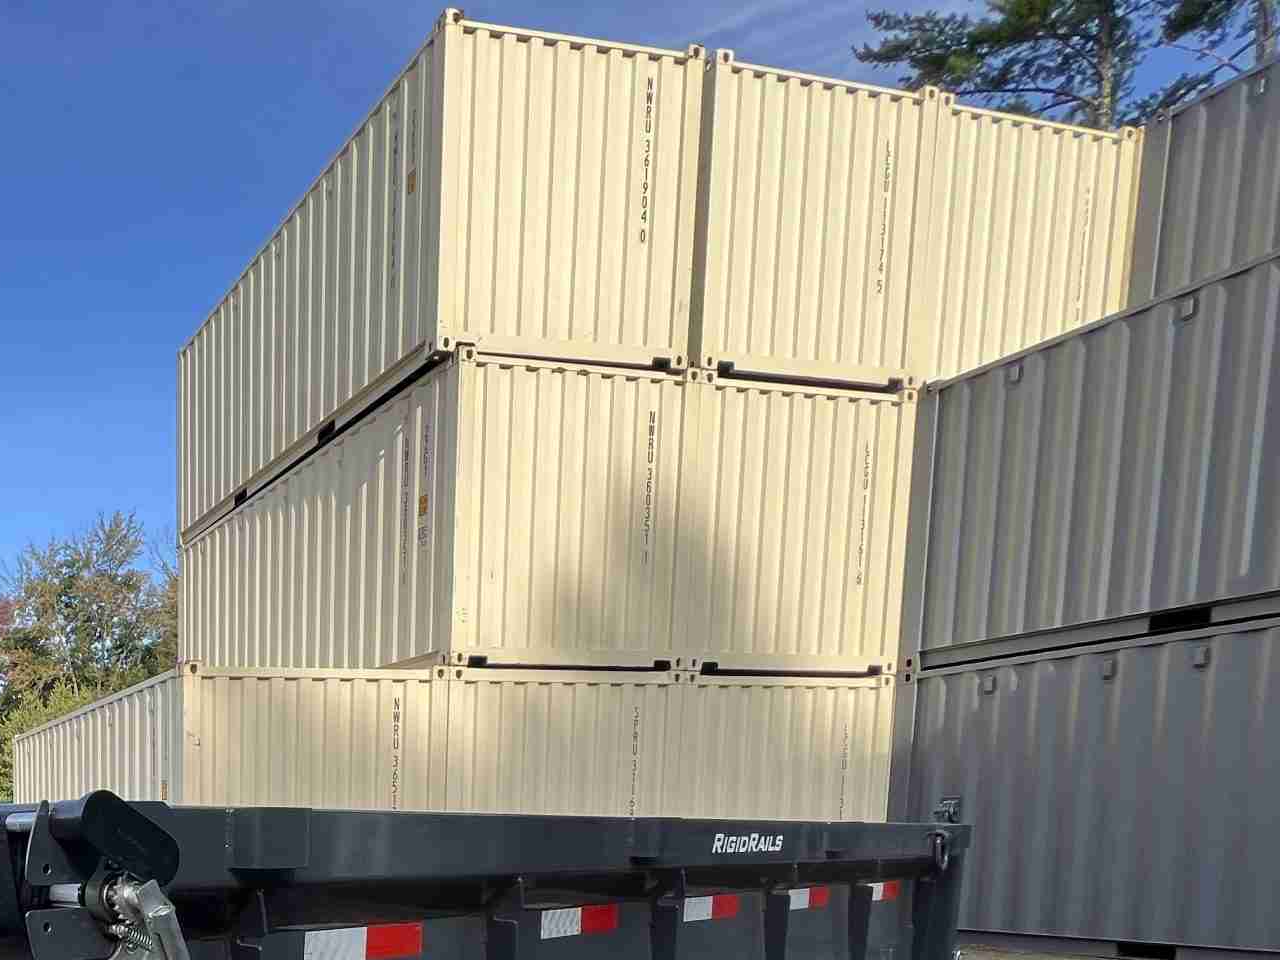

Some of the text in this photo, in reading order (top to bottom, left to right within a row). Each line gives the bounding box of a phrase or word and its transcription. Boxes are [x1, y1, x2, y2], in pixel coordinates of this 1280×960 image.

[645, 77, 653, 134] NWRU
[640, 139, 651, 224] 361904
[647, 410, 656, 464] NWRU
[641, 467, 652, 546] 360351
